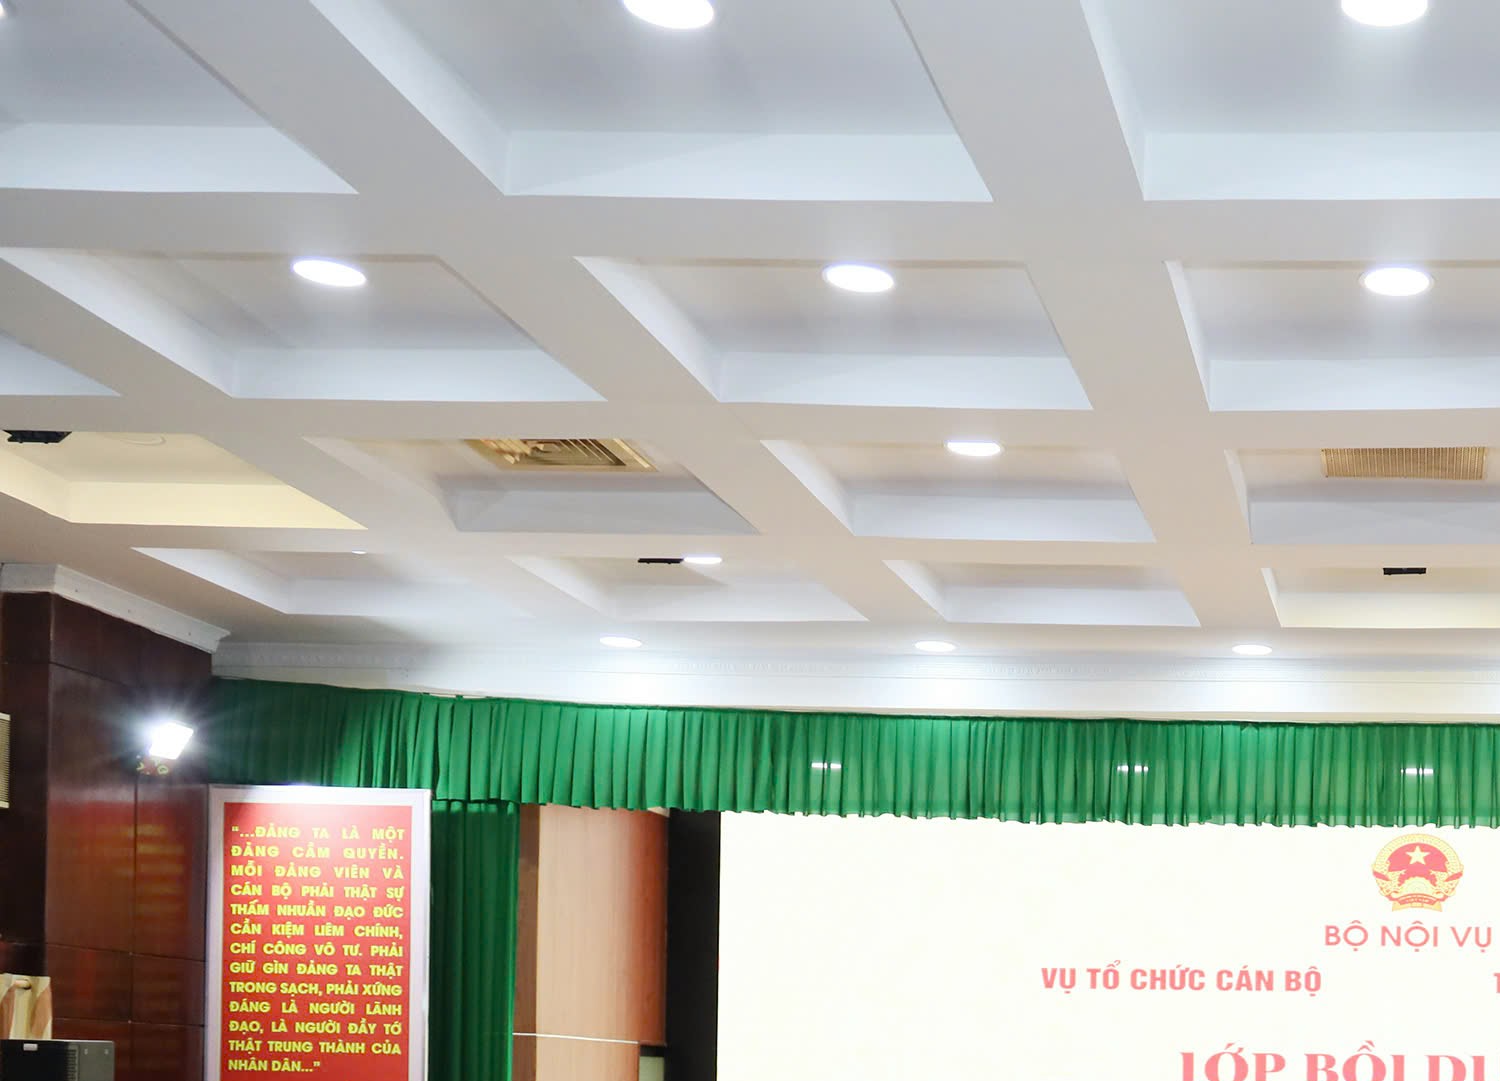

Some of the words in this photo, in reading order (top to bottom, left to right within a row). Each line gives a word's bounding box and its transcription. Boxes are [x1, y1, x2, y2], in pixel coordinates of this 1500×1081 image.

[312, 828, 329, 838] TA
[342, 826, 359, 839] LÀ
[372, 827, 405, 841] MỘT
[231, 842, 279, 857] ĐẢNG
[275, 863, 321, 878] ĐẢNG
[334, 865, 369, 878] VIÊN
[383, 865, 404, 879] VÀ
[231, 882, 262, 896] CÁN
[272, 883, 292, 899] BỘ
[302, 883, 333, 897] PHẢI
[344, 884, 377, 900] THẬT
[386, 887, 404, 901] SỰ
[231, 900, 269, 915] THẤM
[334, 906, 365, 920] ĐẠO
[374, 904, 403, 917] ĐỨC
[272, 922, 304, 938] KIỆM
[315, 922, 344, 936] LIÊM
[1325, 919, 1369, 952] BỘ
[1381, 919, 1439, 952] NỘI
[1451, 927, 1492, 953] VỤ
[230, 941, 255, 953] CHÍ
[263, 941, 306, 955] CÔNG
[315, 942, 335, 956] VÔ
[343, 944, 362, 956] TƯ.
[371, 941, 403, 957] PHẢI
[230, 960, 255, 973] GIỮ
[263, 961, 288, 974] GÌN
[297, 961, 338, 975] ĐẢNG
[346, 964, 361, 976] TA
[370, 963, 402, 979] THẬT
[1041, 967, 1077, 995] VỤ
[1086, 960, 1121, 990] TỔ
[1130, 964, 1206, 991] CHỨC
[1216, 965, 1274, 992] CÁN
[1284, 965, 1321, 997] BỘ
[229, 982, 277, 993] TRONG
[326, 981, 358, 995] PHẢI
[362, 982, 402, 996] XỨNG
[229, 998, 270, 1013] ĐÁNG
[282, 999, 297, 1013] LÀ
[310, 1000, 354, 1014] NGƯỜI
[366, 1001, 402, 1015] LÃNH
[229, 1021, 264, 1034] ĐẠO,
[272, 1019, 287, 1032] LÀ
[295, 1020, 340, 1034] NGƯỜI
[384, 1021, 402, 1035] TỚ
[229, 1037, 261, 1054] THẬT
[268, 1040, 313, 1053] TRUNG
[319, 1040, 365, 1054] THÀNH
[371, 1040, 401, 1054] CỦA
[228, 1058, 267, 1071] NHÂN
